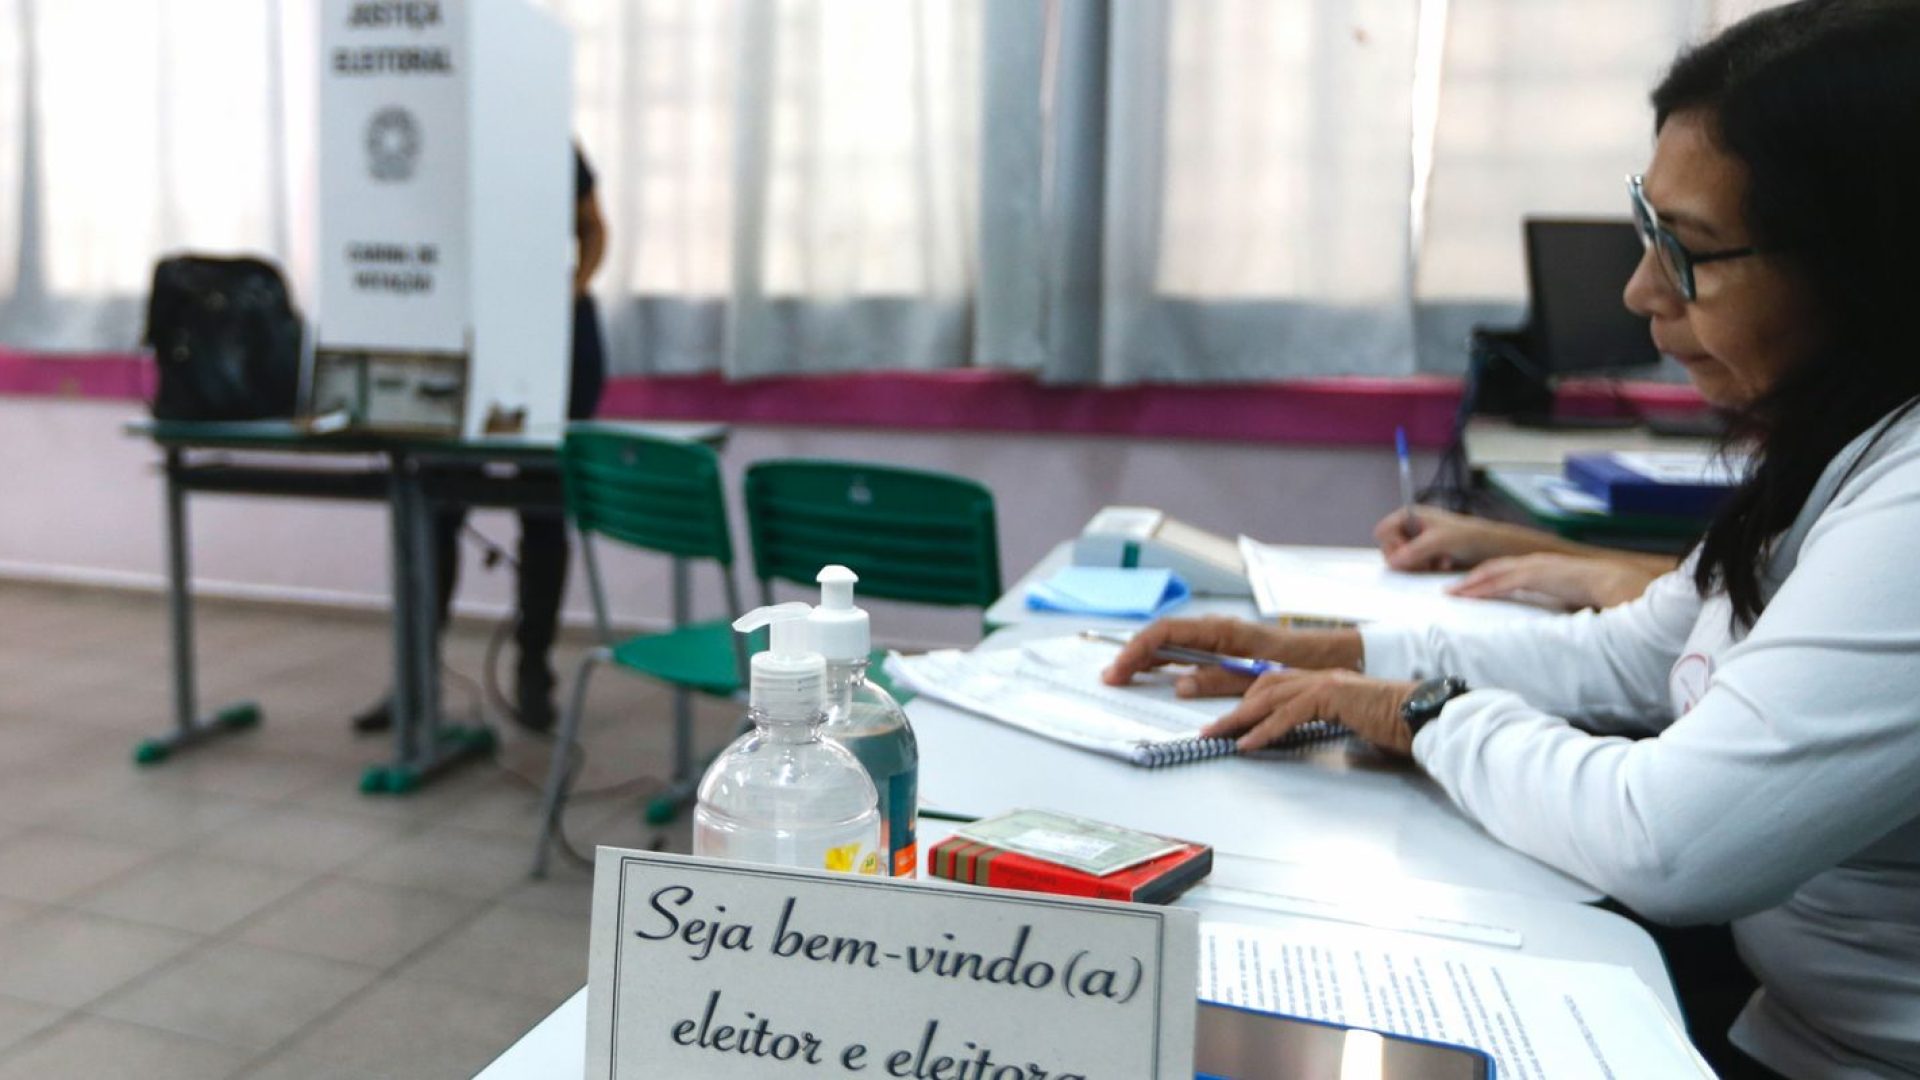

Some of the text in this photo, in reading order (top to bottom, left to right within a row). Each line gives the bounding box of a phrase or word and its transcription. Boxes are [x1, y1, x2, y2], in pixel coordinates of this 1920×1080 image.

[332, 45, 454, 75] ELEITORAL
[634, 885, 1143, 1004] Seja bem-vindo(a)
[671, 989, 1086, 1080] eleitor e eleitor
